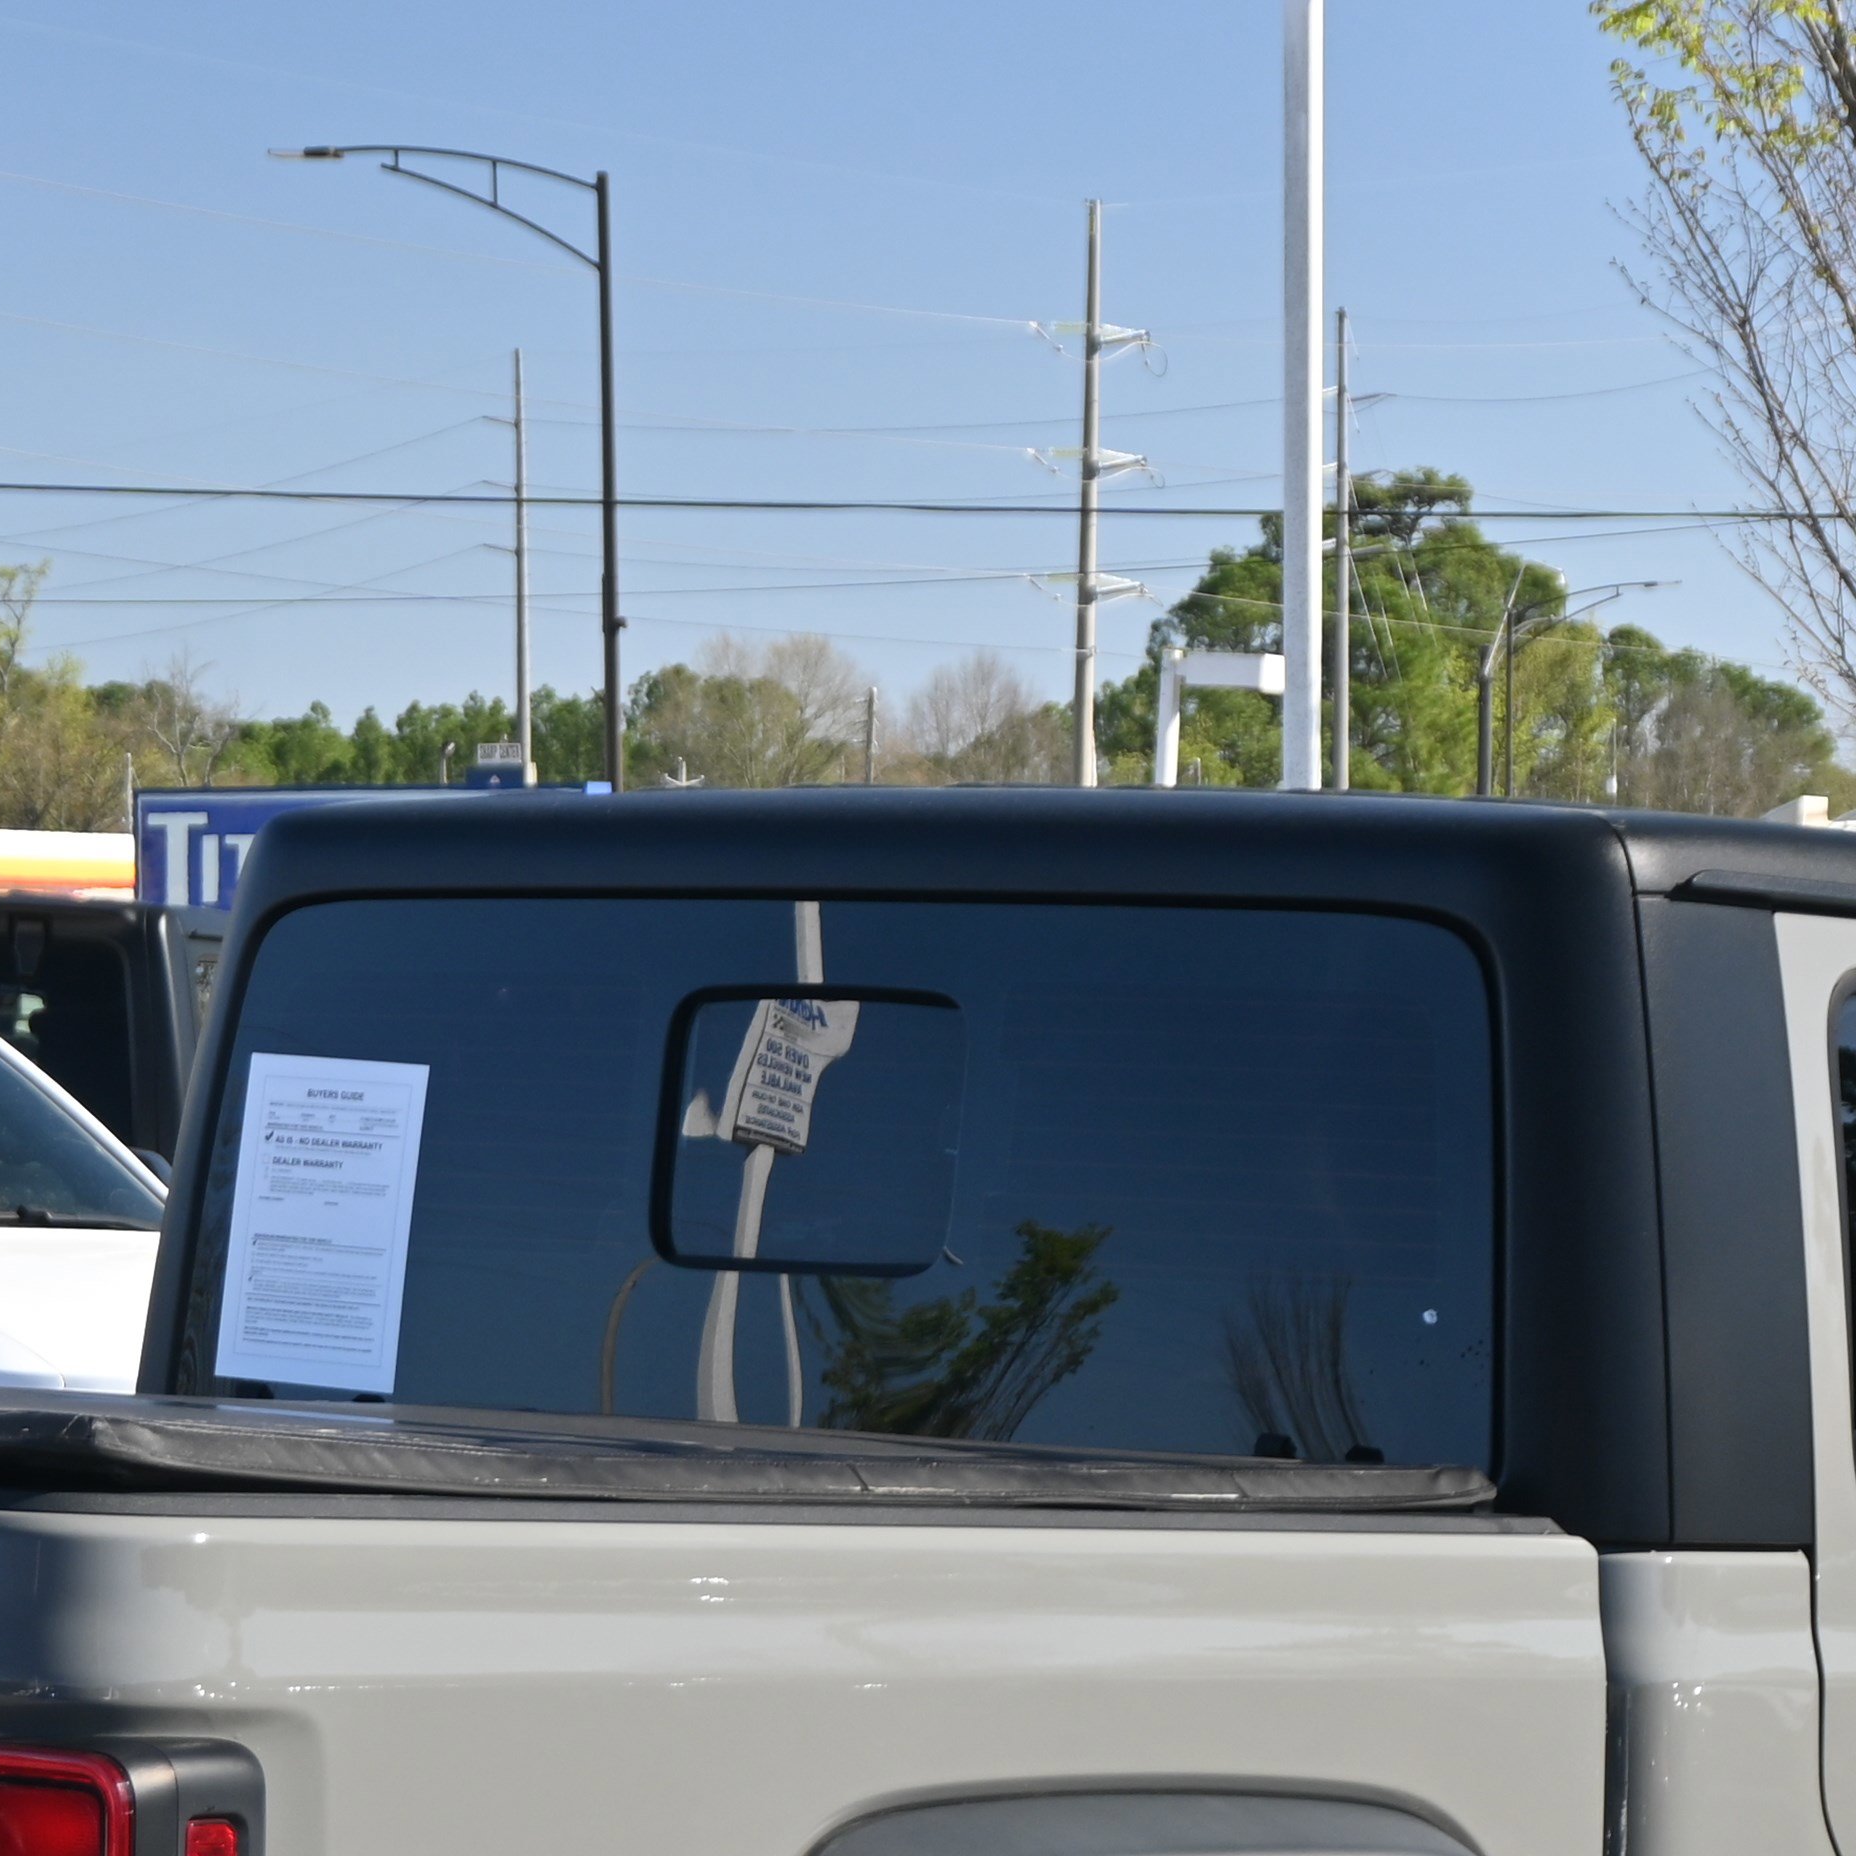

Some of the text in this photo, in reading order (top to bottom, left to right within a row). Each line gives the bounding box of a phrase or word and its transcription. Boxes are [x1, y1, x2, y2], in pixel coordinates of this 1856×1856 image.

[306, 1088, 365, 1101] BUYERS GUIDE
[275, 1135, 285, 1144] AS
[299, 1137, 310, 1146] NO
[311, 1138, 340, 1148] DEALER
[341, 1139, 384, 1151] WARRANTY
[272, 1156, 344, 1170] DEALER WARRANTY
